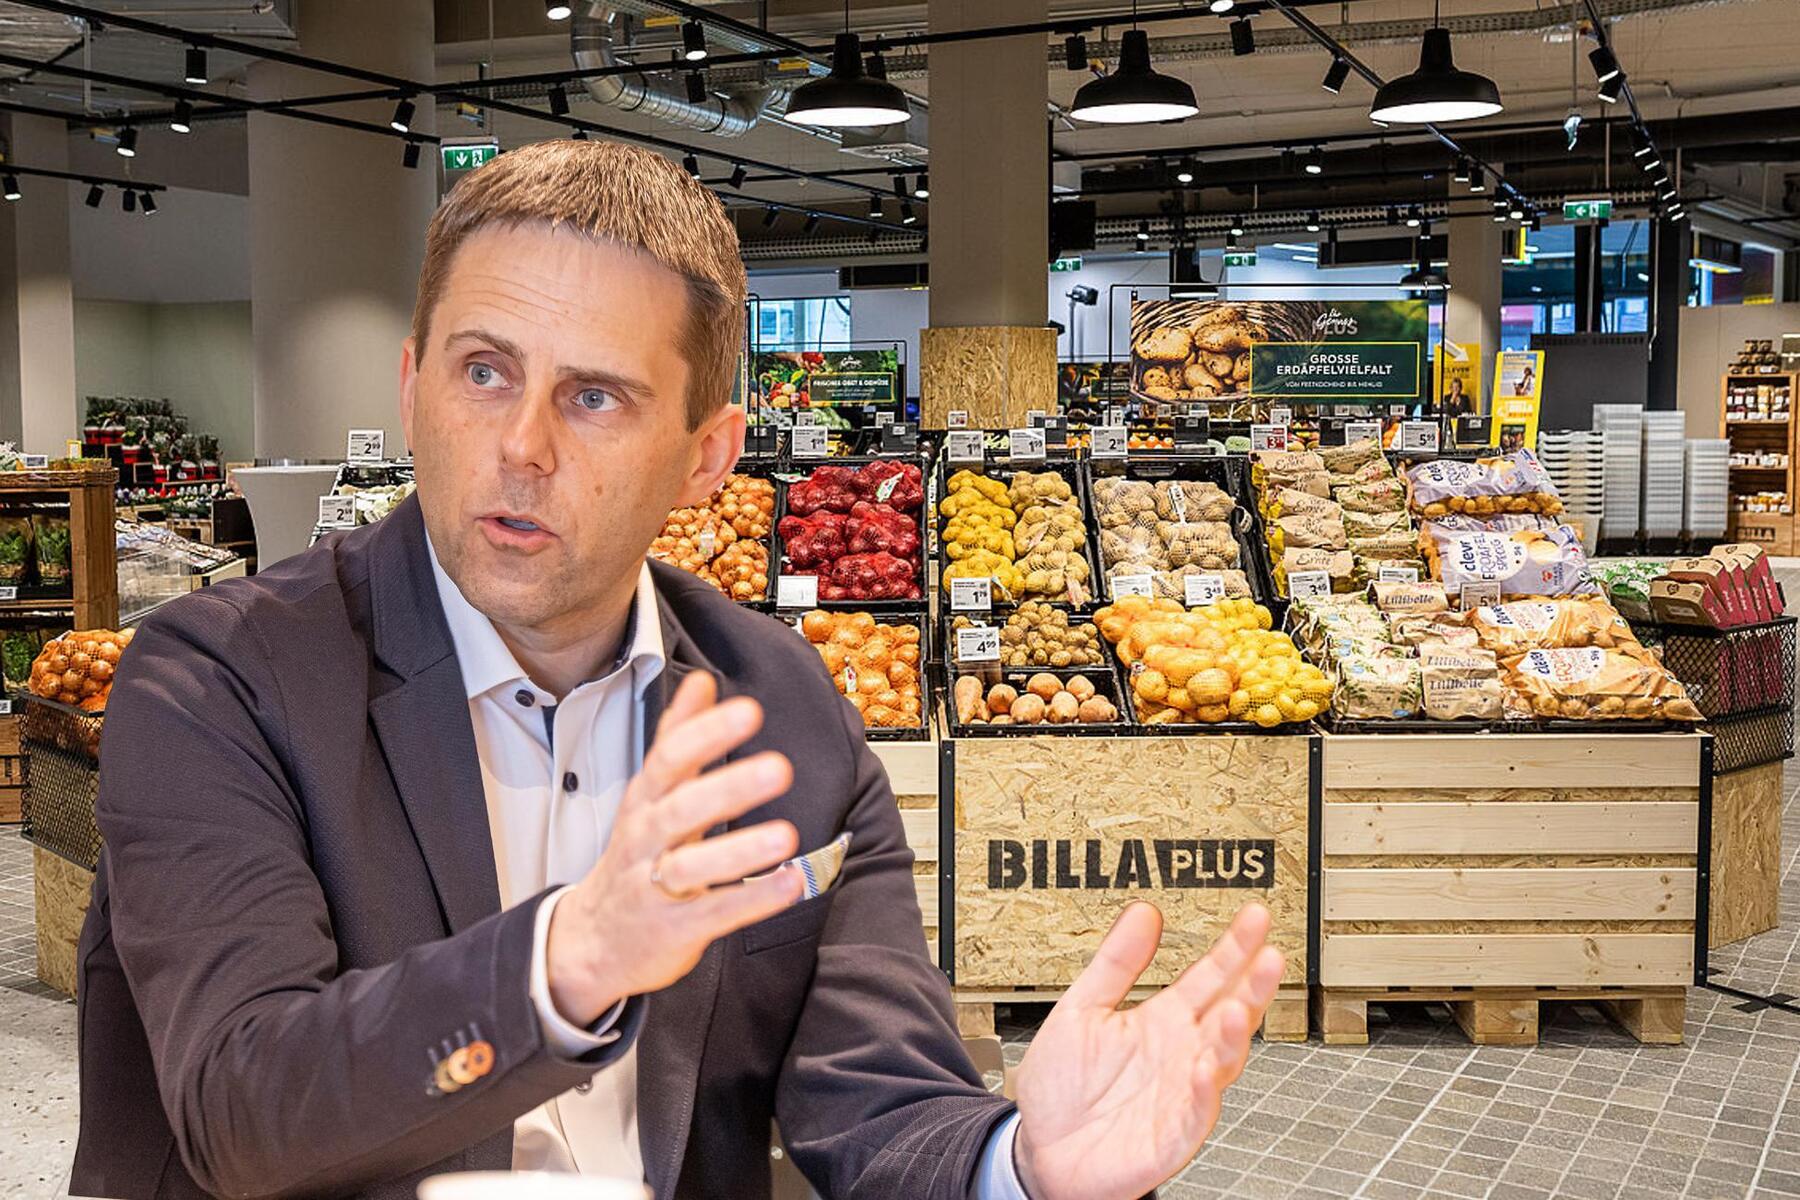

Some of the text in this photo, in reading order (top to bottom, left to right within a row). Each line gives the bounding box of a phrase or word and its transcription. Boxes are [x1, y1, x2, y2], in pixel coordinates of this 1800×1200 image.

[1310, 354, 1359, 364] GROSSE
[1276, 362, 1393, 375] ERDÄPFELVIELFALT
[988, 839, 1265, 889] BILLA PLUS
